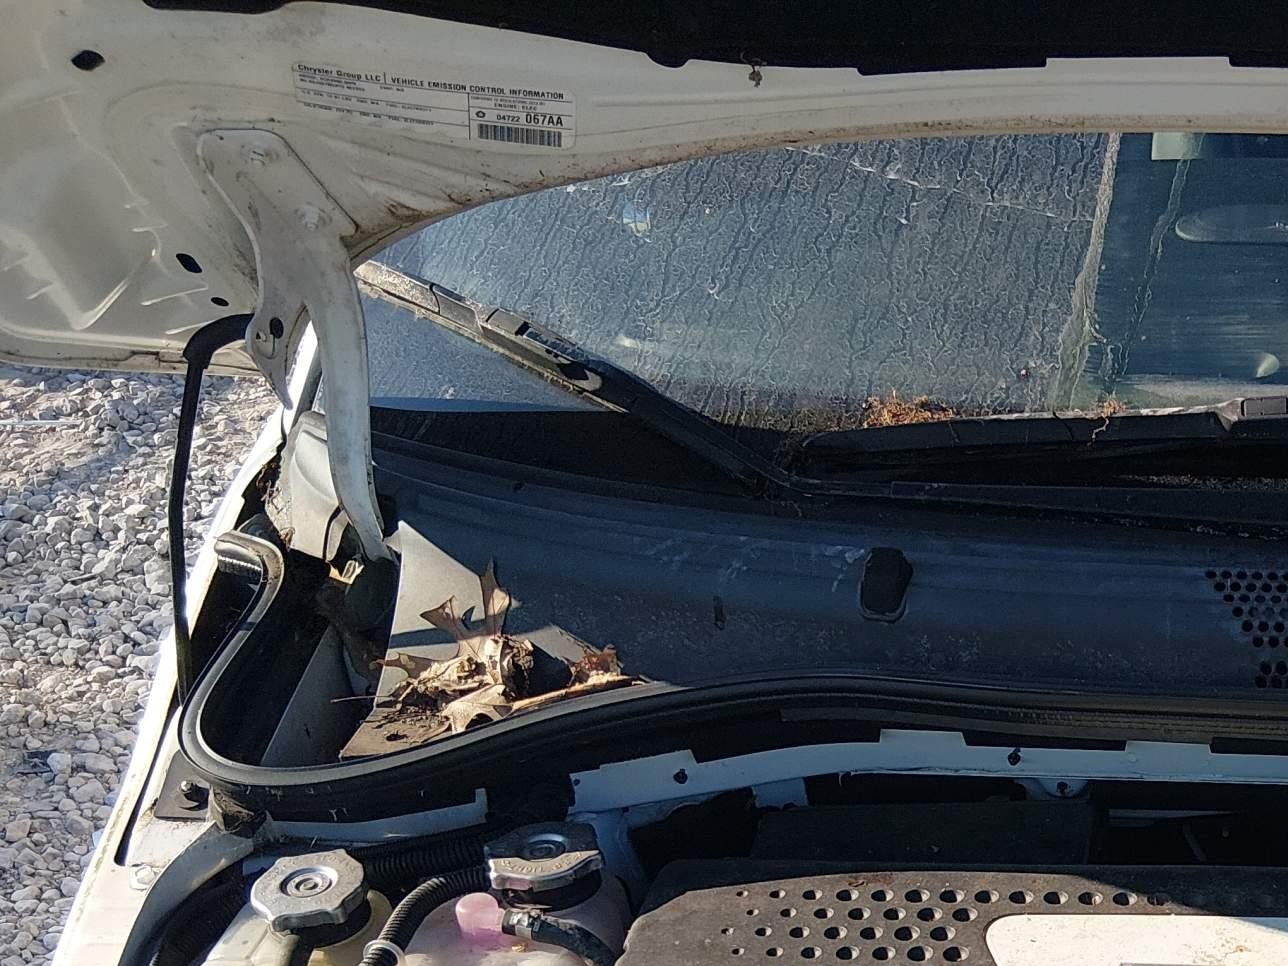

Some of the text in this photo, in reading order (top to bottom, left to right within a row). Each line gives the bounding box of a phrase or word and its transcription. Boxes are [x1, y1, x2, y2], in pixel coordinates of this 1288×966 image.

[298, 64, 333, 75] Chrysler
[336, 70, 362, 80] Group
[364, 73, 381, 82] LLC
[391, 77, 564, 100] VEHICLE EMISSION CONTROL INFORMATION
[496, 113, 564, 127] 04722 067AA
